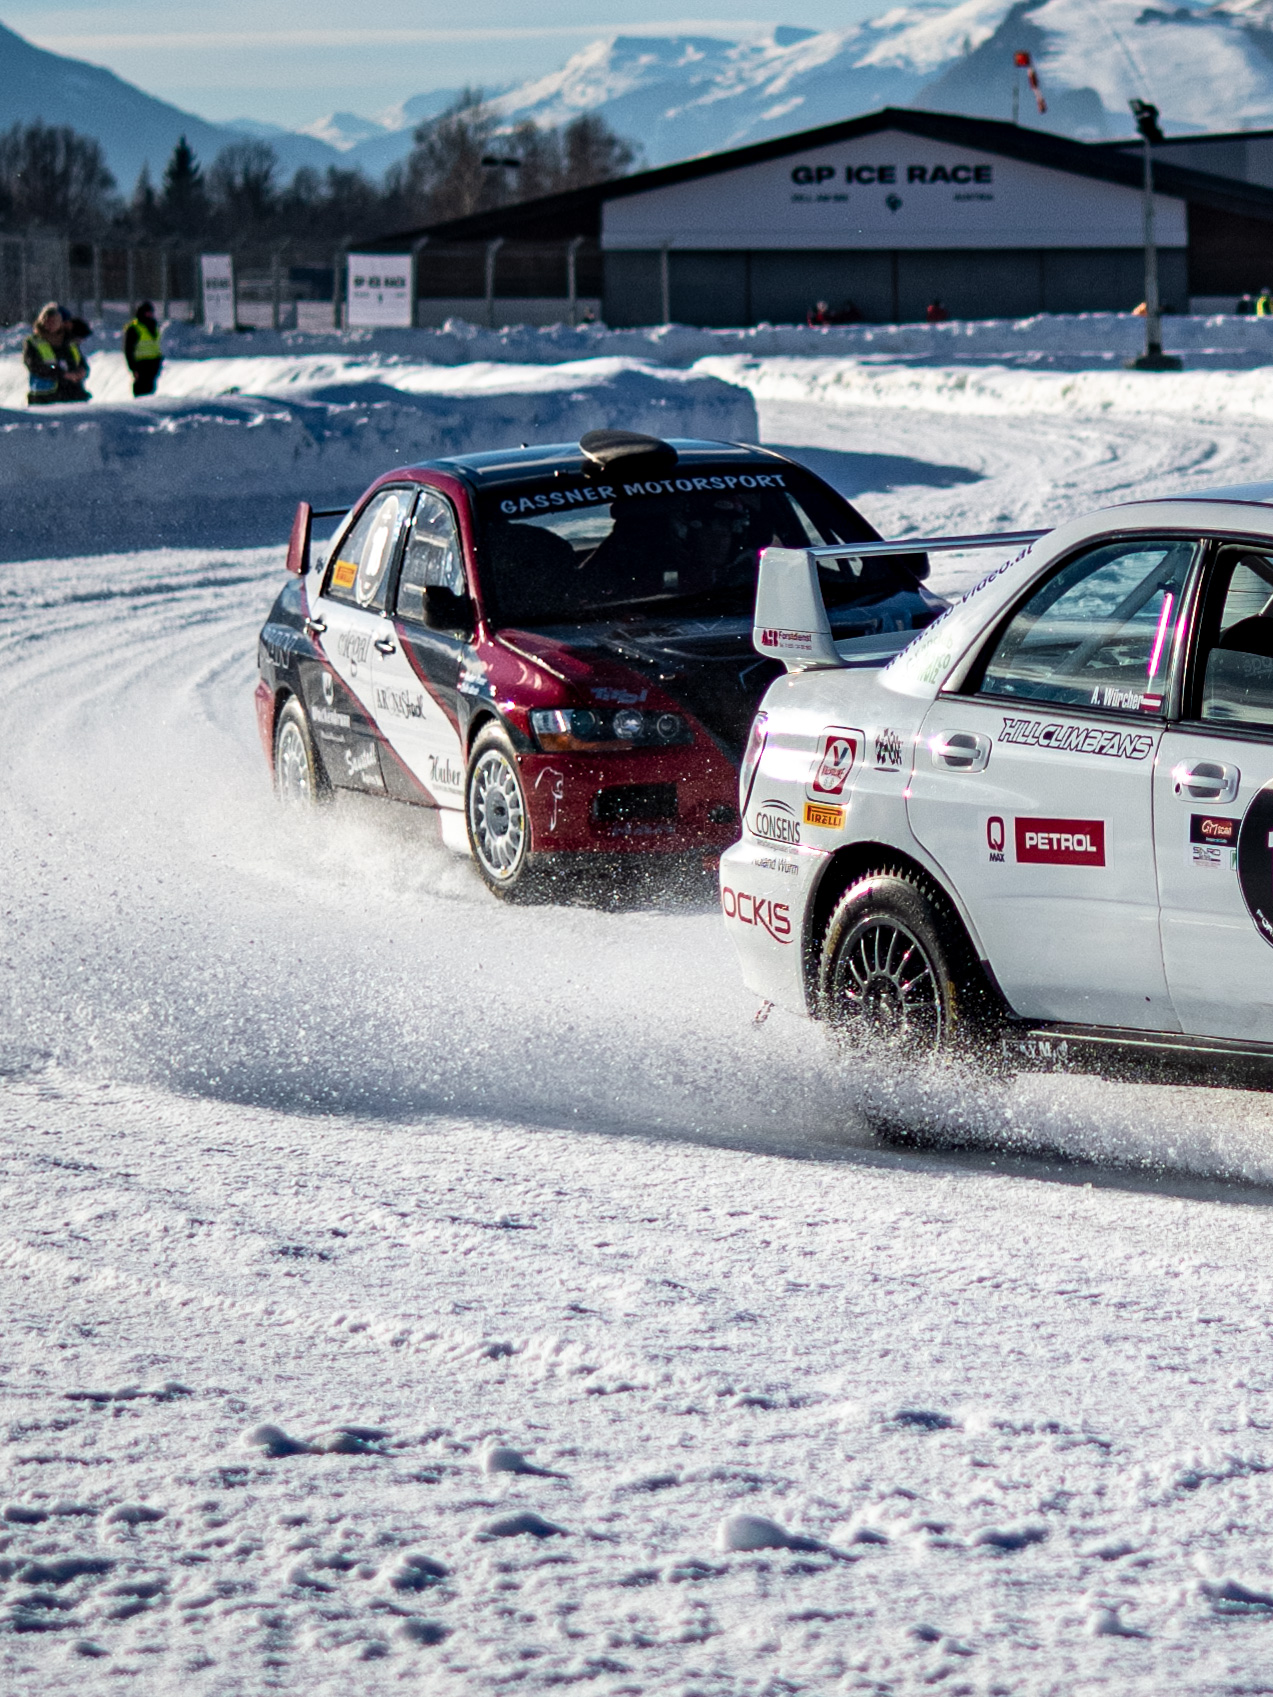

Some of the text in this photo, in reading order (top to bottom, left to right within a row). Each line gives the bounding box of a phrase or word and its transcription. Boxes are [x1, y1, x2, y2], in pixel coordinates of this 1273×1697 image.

[791, 165, 992, 185] GP ICE RACE
[500, 474, 786, 514] GASSNER MOTORSPORT
[1091, 685, 1144, 710] A. Würcher
[998, 717, 1154, 760] HILLCLIMBFANS
[756, 812, 800, 843] CONSENS
[806, 804, 842, 827] PIRELLI
[1025, 832, 1097, 852] PETROL
[989, 852, 1005, 862] MAX
